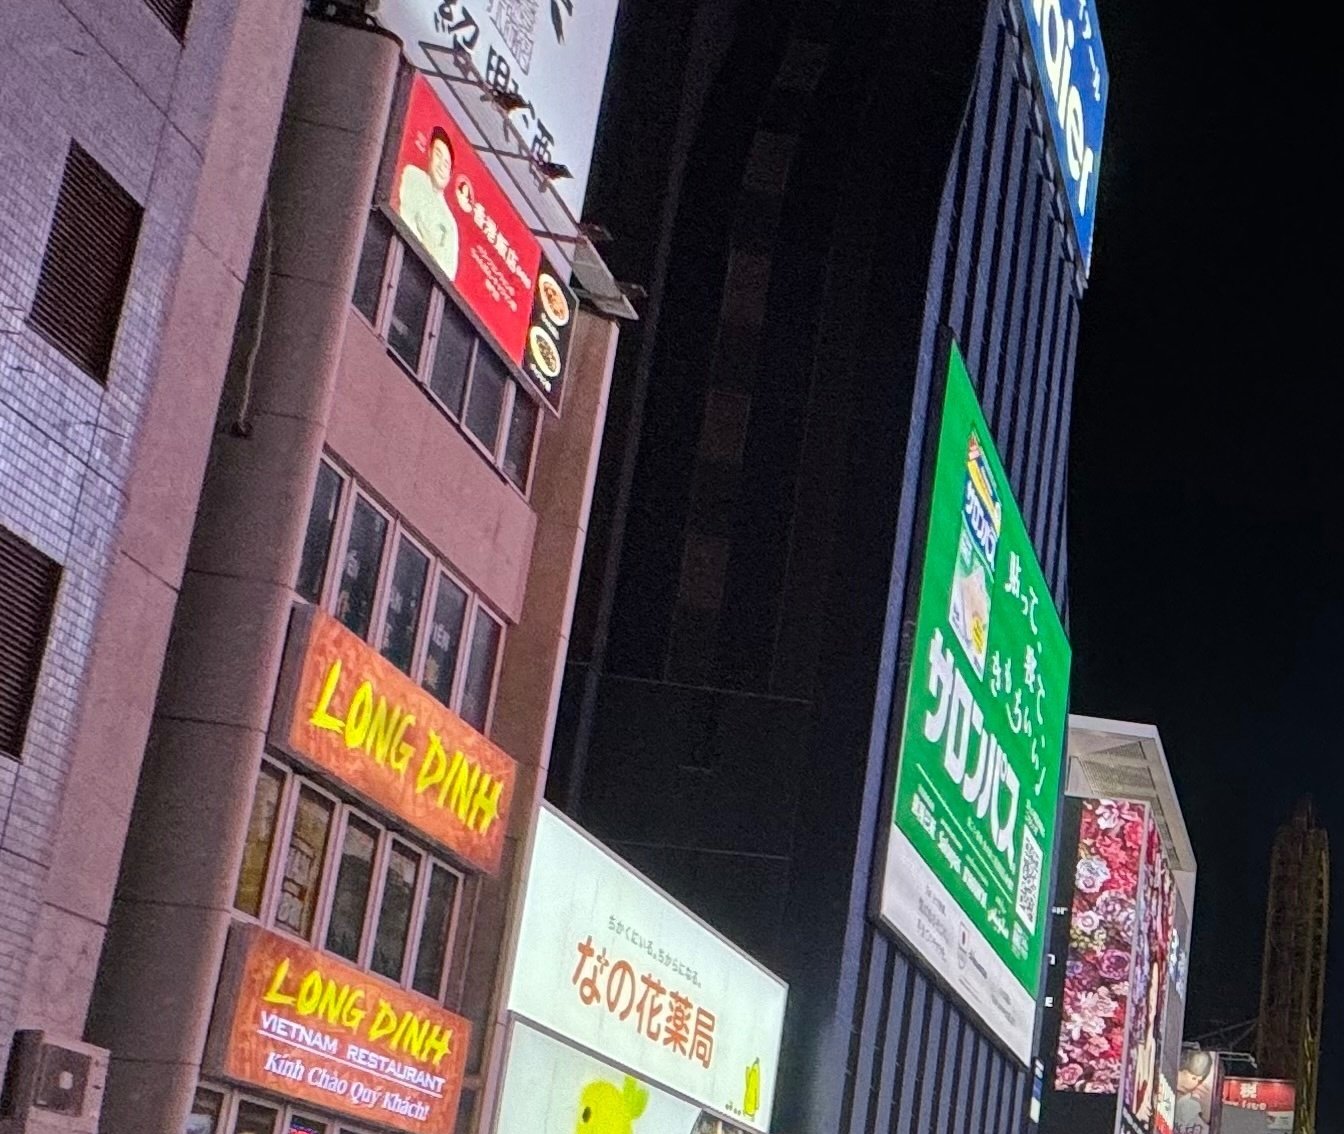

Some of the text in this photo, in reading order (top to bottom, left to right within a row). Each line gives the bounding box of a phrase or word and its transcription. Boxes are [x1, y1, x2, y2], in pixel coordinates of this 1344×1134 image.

[1033, 0, 1093, 216] aier
[309, 658, 504, 836] LONG DINH
[923, 626, 1017, 866] サロンパス
[256, 1010, 446, 1096] VIETNAM RESTAURANT
[263, 958, 452, 1066] LONG DINH
[263, 1051, 307, 1085] Kính
[572, 935, 717, 1069] なの花薬局
